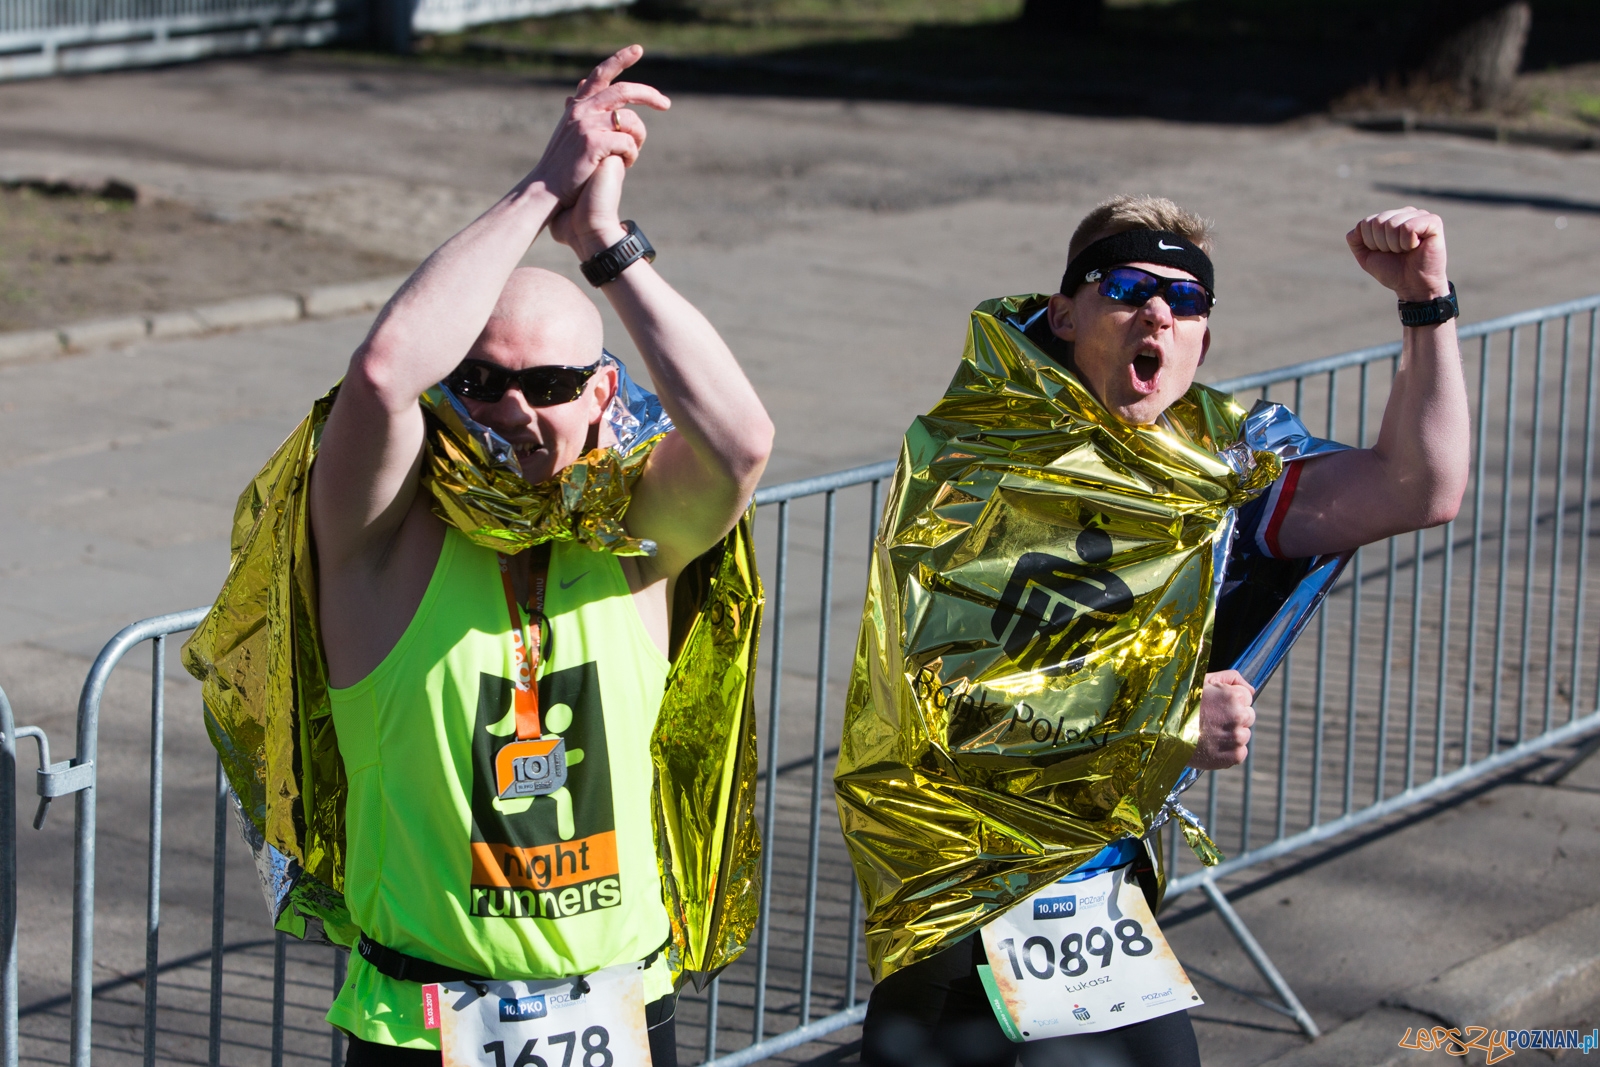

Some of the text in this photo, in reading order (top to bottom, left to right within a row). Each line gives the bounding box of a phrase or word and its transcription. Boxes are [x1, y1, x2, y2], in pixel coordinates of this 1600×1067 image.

[914, 667, 997, 726] Bank
[512, 756, 550, 781] 10
[503, 841, 590, 887] night
[472, 878, 621, 917] runners
[1053, 901, 1074, 913] PKO
[997, 919, 1153, 980] 10898
[1065, 975, 1112, 993] Łukasz
[426, 992, 436, 1026] 26.03.2017
[520, 1000, 543, 1015] PKO
[483, 1025, 614, 1067] 1678
